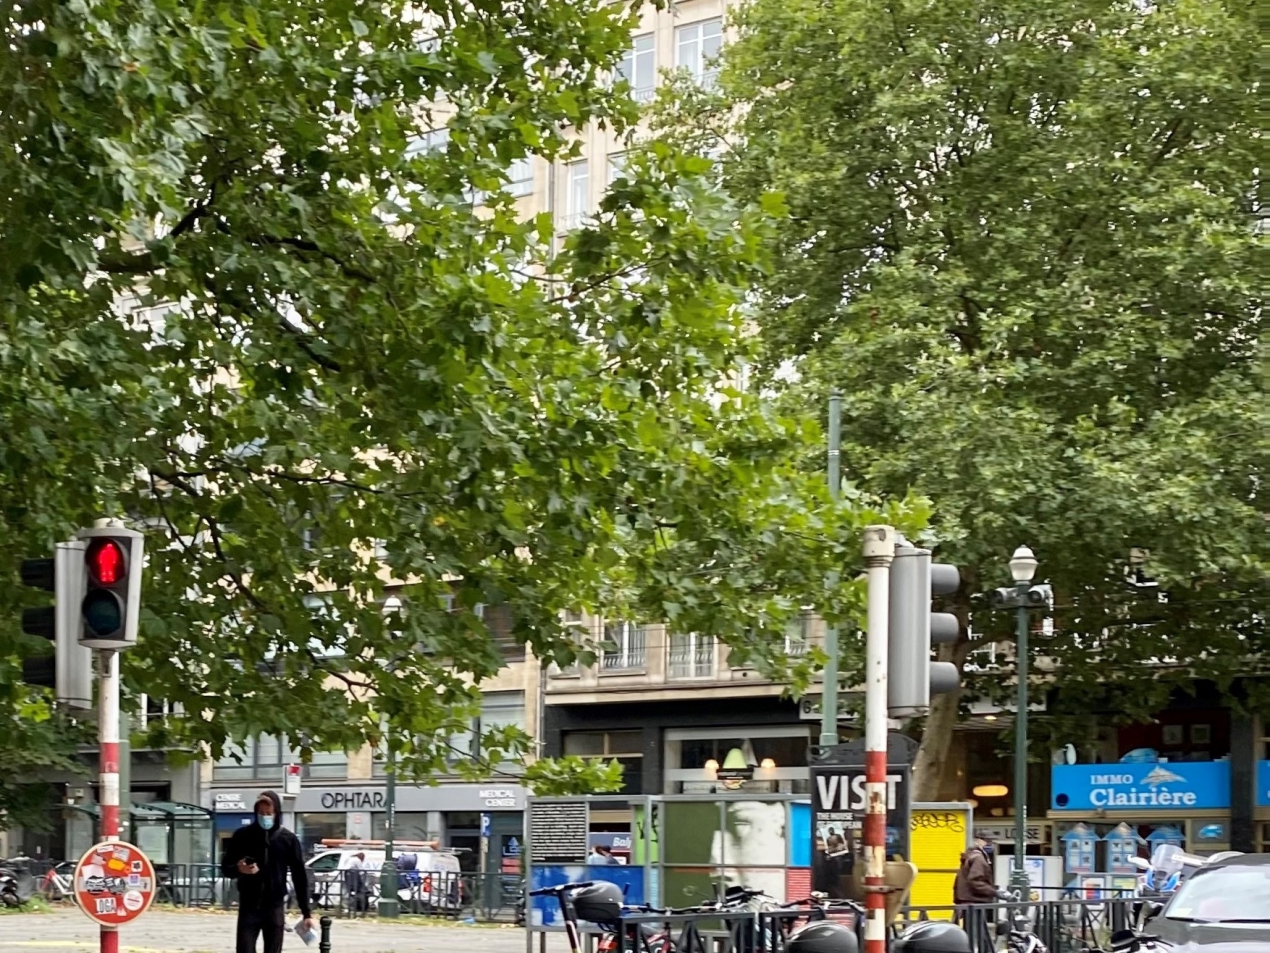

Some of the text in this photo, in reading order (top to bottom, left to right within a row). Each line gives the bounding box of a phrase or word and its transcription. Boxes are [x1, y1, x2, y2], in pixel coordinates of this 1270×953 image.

[1091, 775, 1133, 784] IMMO
[479, 790, 516, 798] MEDICAL
[816, 775, 902, 810] VIST
[1089, 787, 1196, 806] Clairière
[485, 798, 516, 807] CENTER
